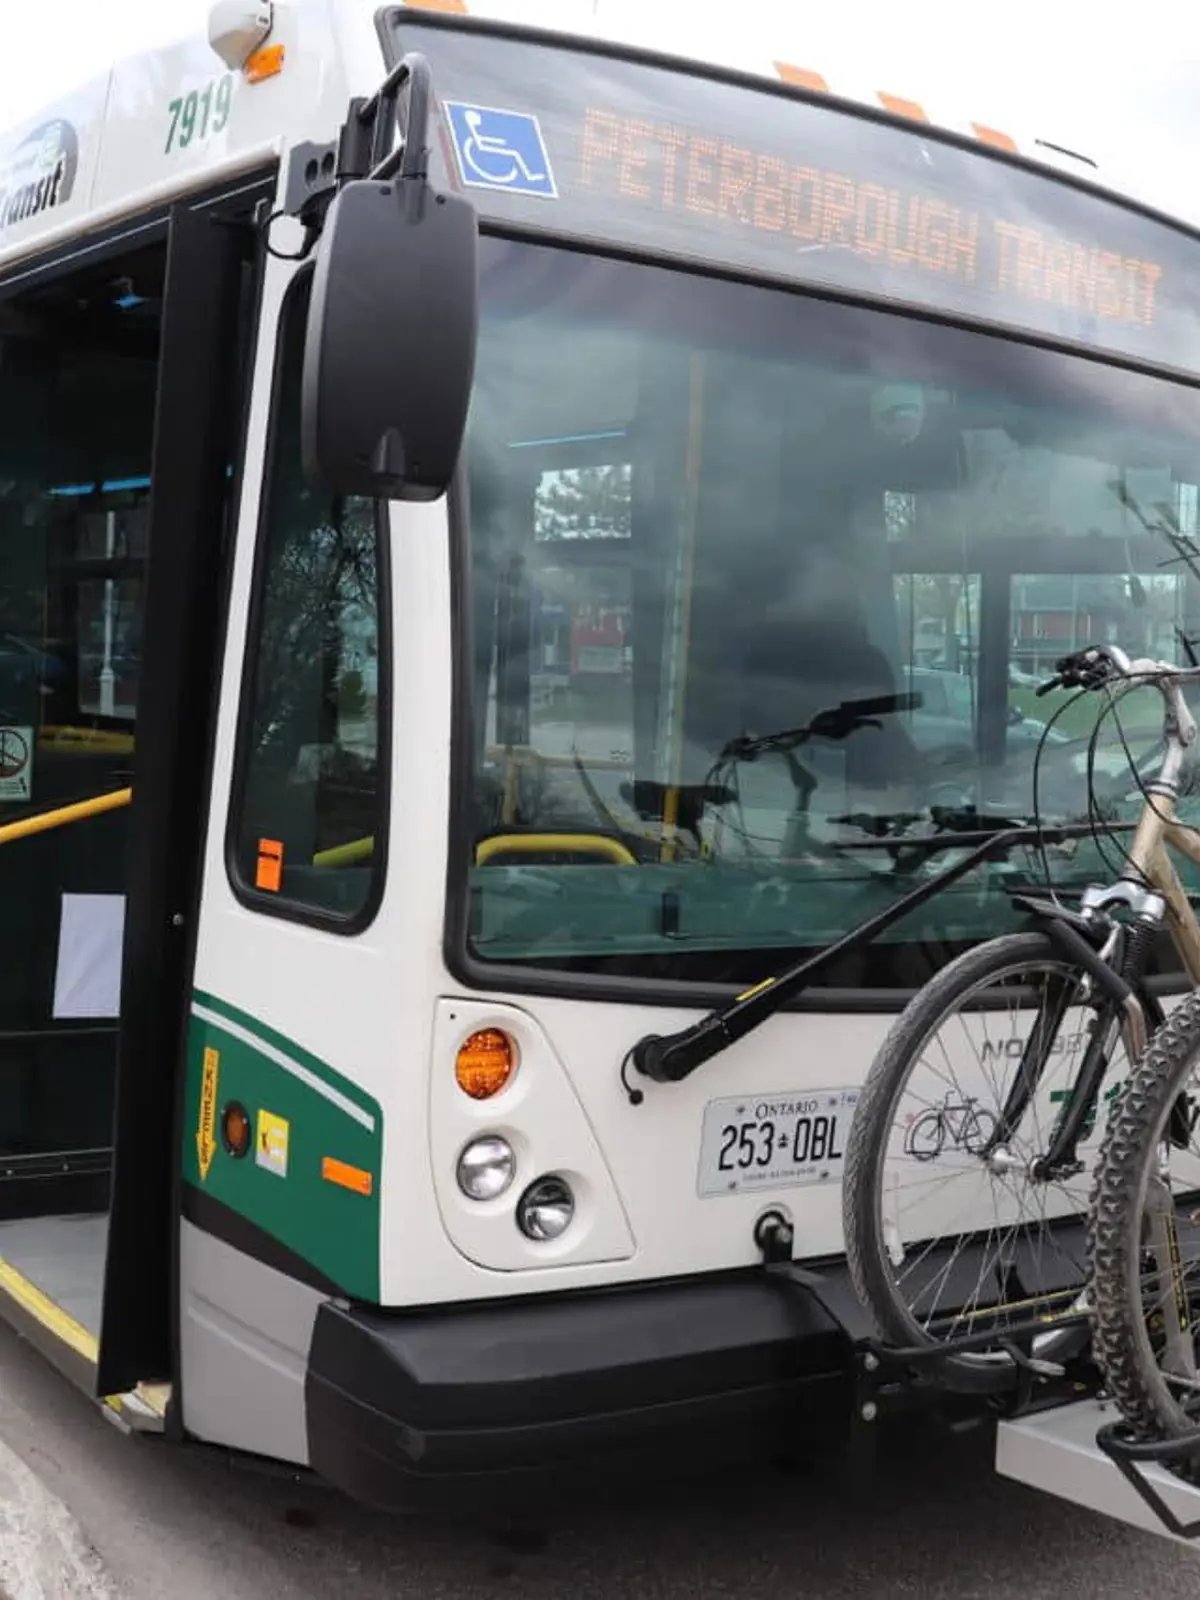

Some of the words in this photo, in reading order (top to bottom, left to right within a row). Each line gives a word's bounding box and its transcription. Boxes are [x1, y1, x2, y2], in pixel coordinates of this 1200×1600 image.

[165, 73, 233, 155] 7919
[576, 106, 978, 283] PETERBOROUGH
[994, 218, 1162, 327] TRANSIT
[718, 1121, 775, 1171] 253
